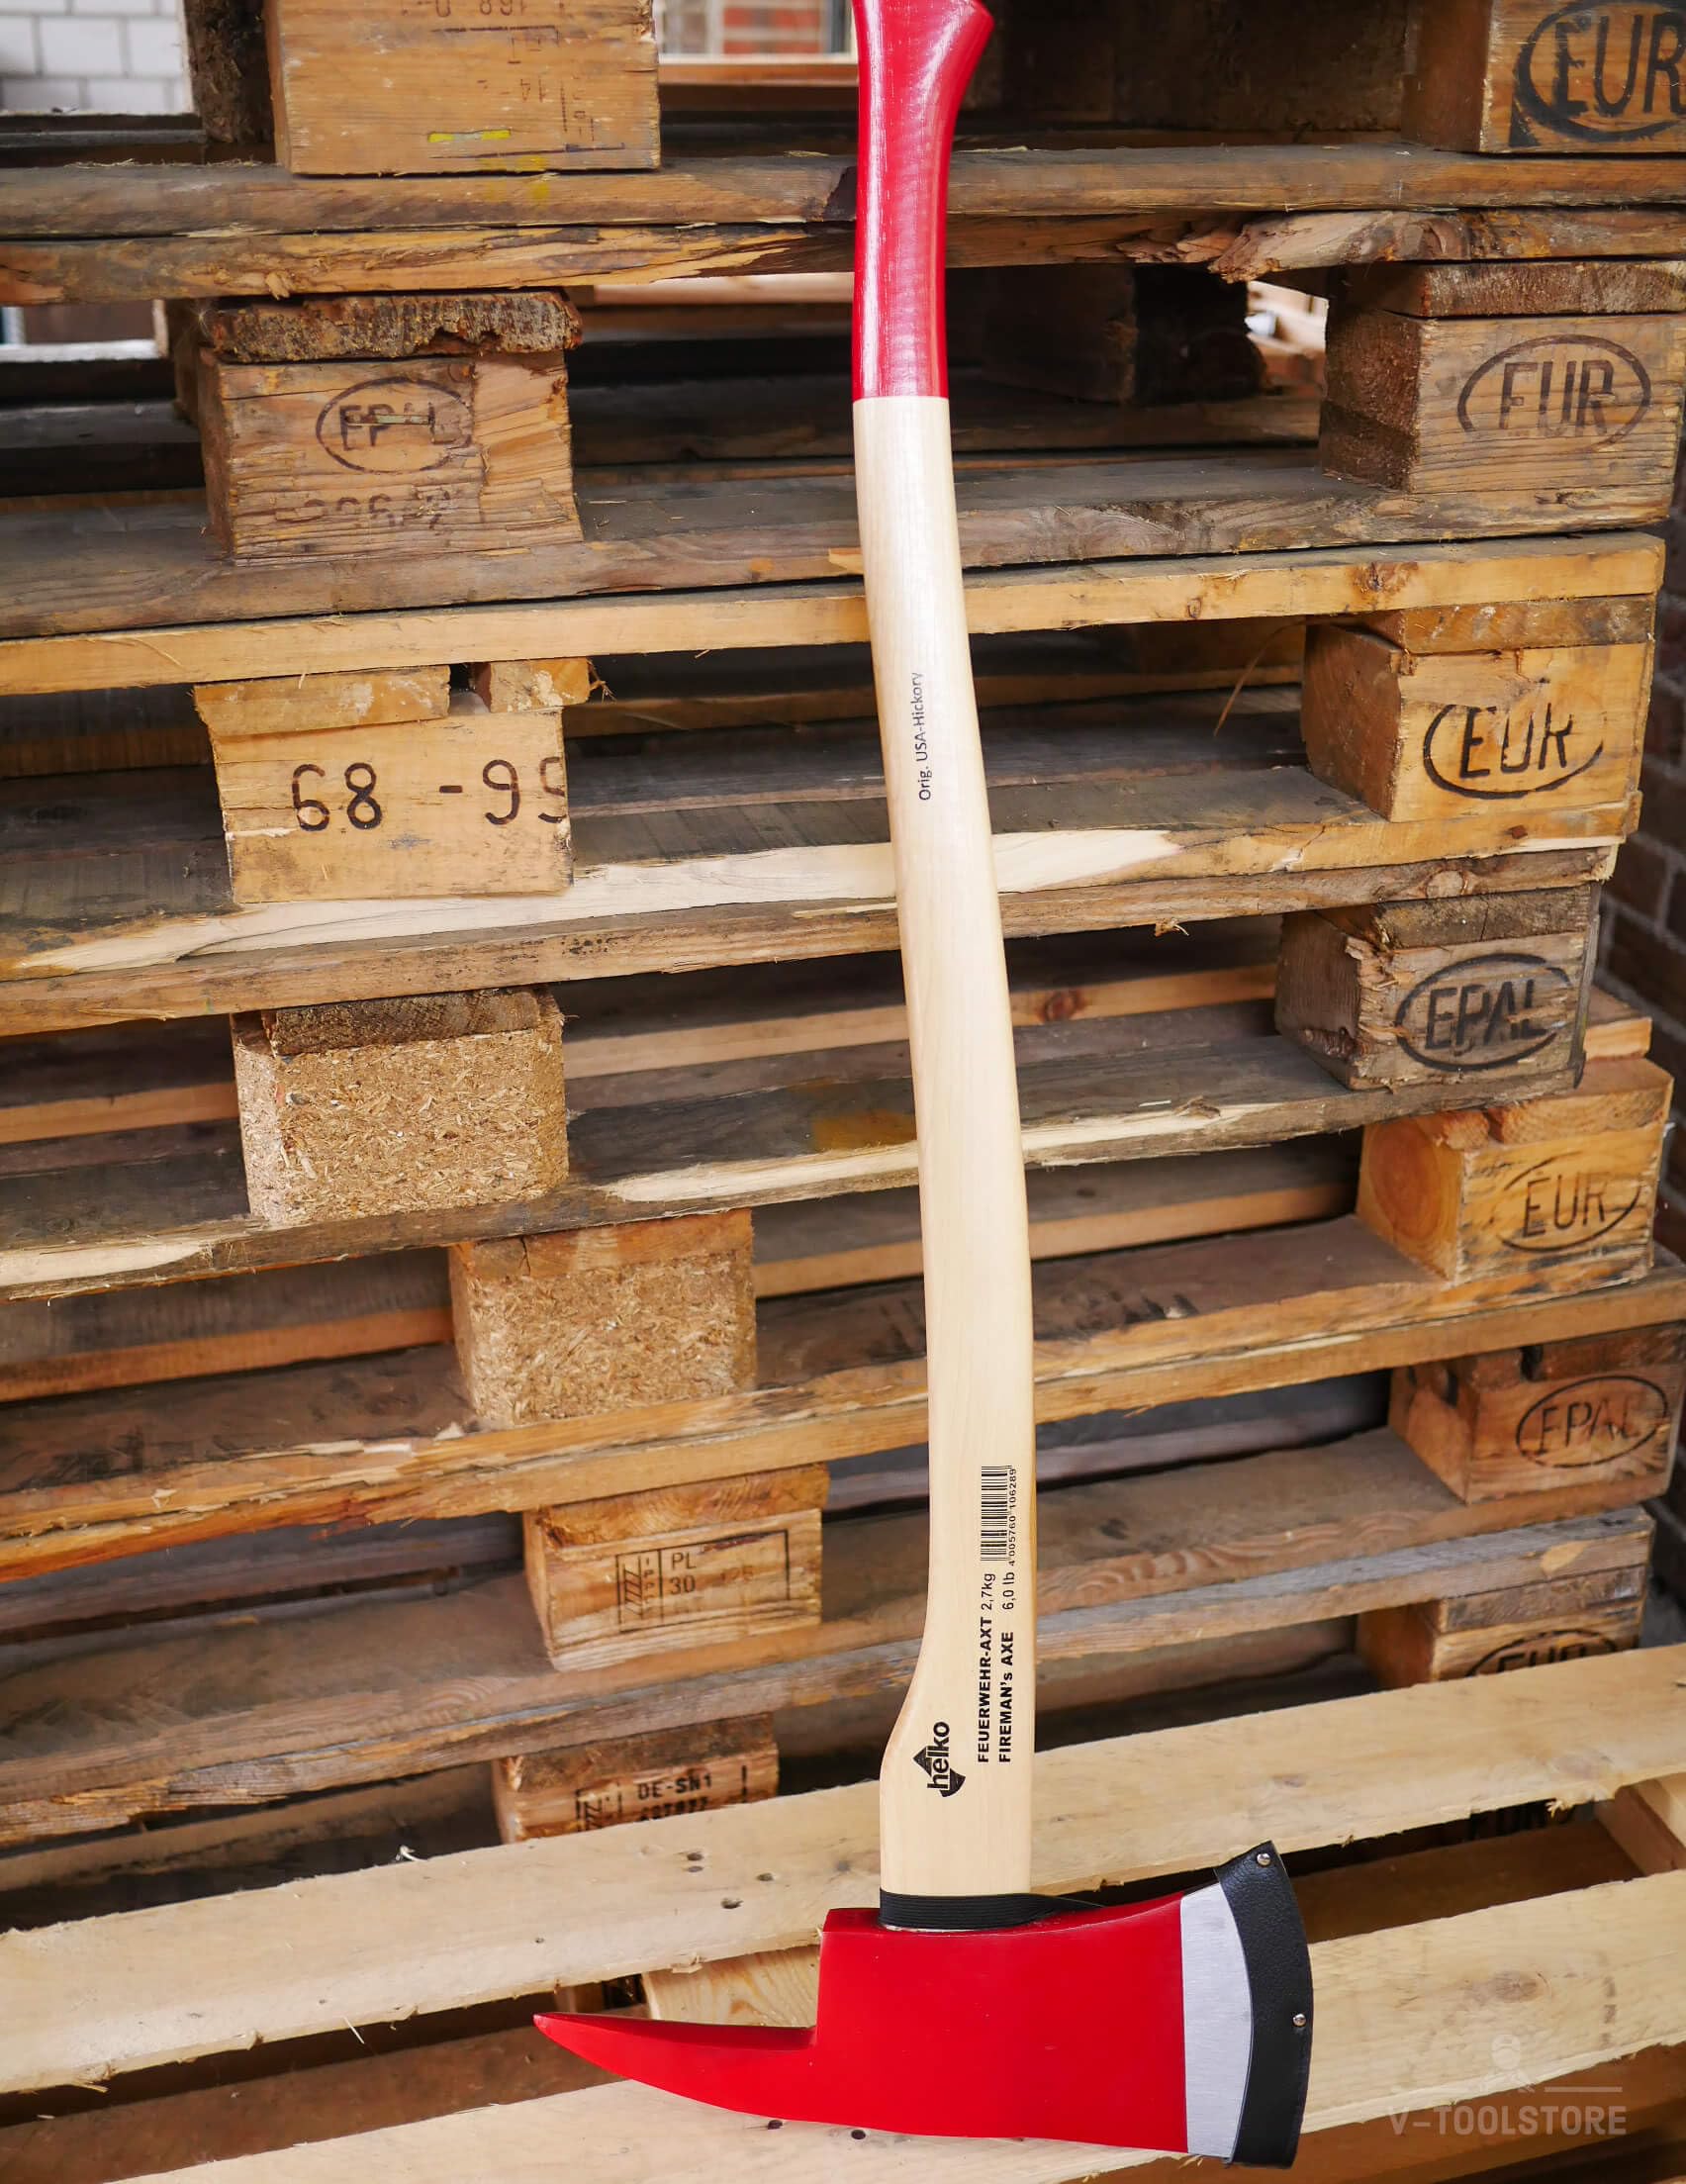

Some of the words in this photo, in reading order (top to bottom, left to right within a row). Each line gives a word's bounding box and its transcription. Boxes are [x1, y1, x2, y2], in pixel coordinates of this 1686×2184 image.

[1552, 12, 1686, 118] EUR
[910, 672, 928, 762] USA-Hickory
[291, 761, 384, 832] 68
[918, 765, 933, 801] Orig.
[1424, 979, 1549, 1050] EPAL
[1523, 1171, 1612, 1238] EUR
[669, 1574, 697, 1596] 30
[671, 1552, 698, 1570] PL
[981, 1572, 996, 1611] 2,7kg
[1001, 1571, 1015, 1585] lb
[1002, 1588, 1017, 1610] 6,0
[1000, 1631, 1014, 1665] AXE
[978, 1616, 992, 1762] FEUERWEHR-AXT
[998, 1671, 1014, 1762] FIREMAN's
[926, 1721, 951, 1789] helko
